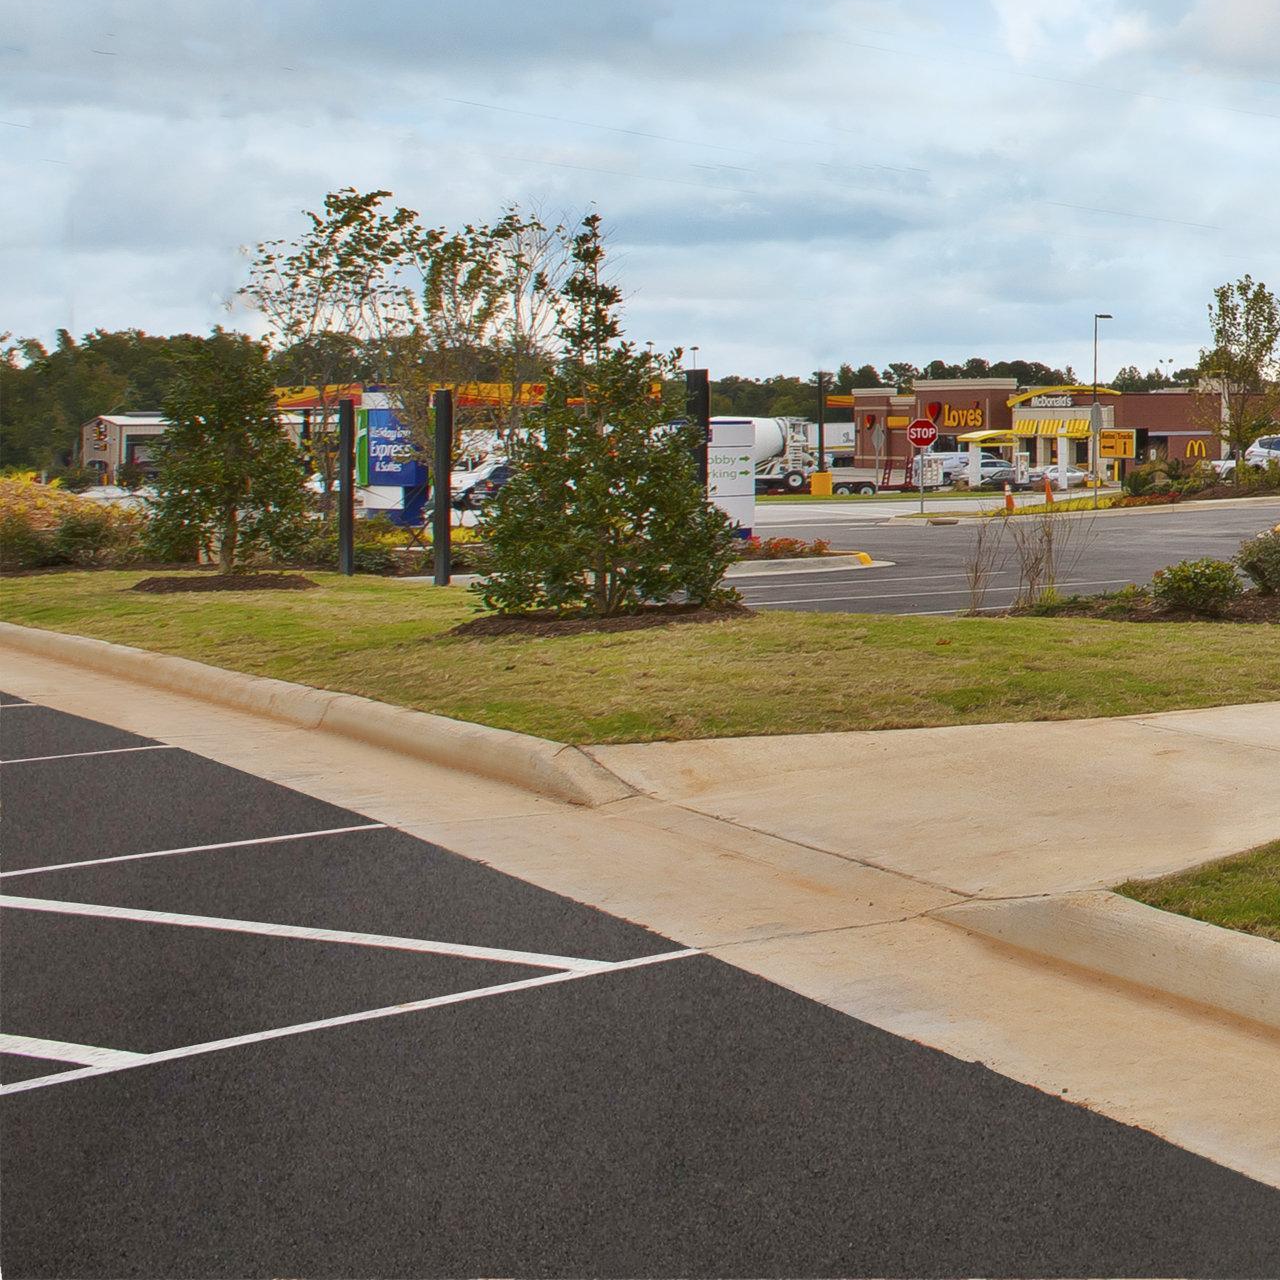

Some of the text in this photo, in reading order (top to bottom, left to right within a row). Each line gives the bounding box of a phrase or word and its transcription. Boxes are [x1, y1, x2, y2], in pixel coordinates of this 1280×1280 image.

[1030, 395, 1073, 407] McDonald's
[944, 402, 983, 427] Love's
[909, 427, 936, 439] STOP
[707, 454, 736, 465] obby
